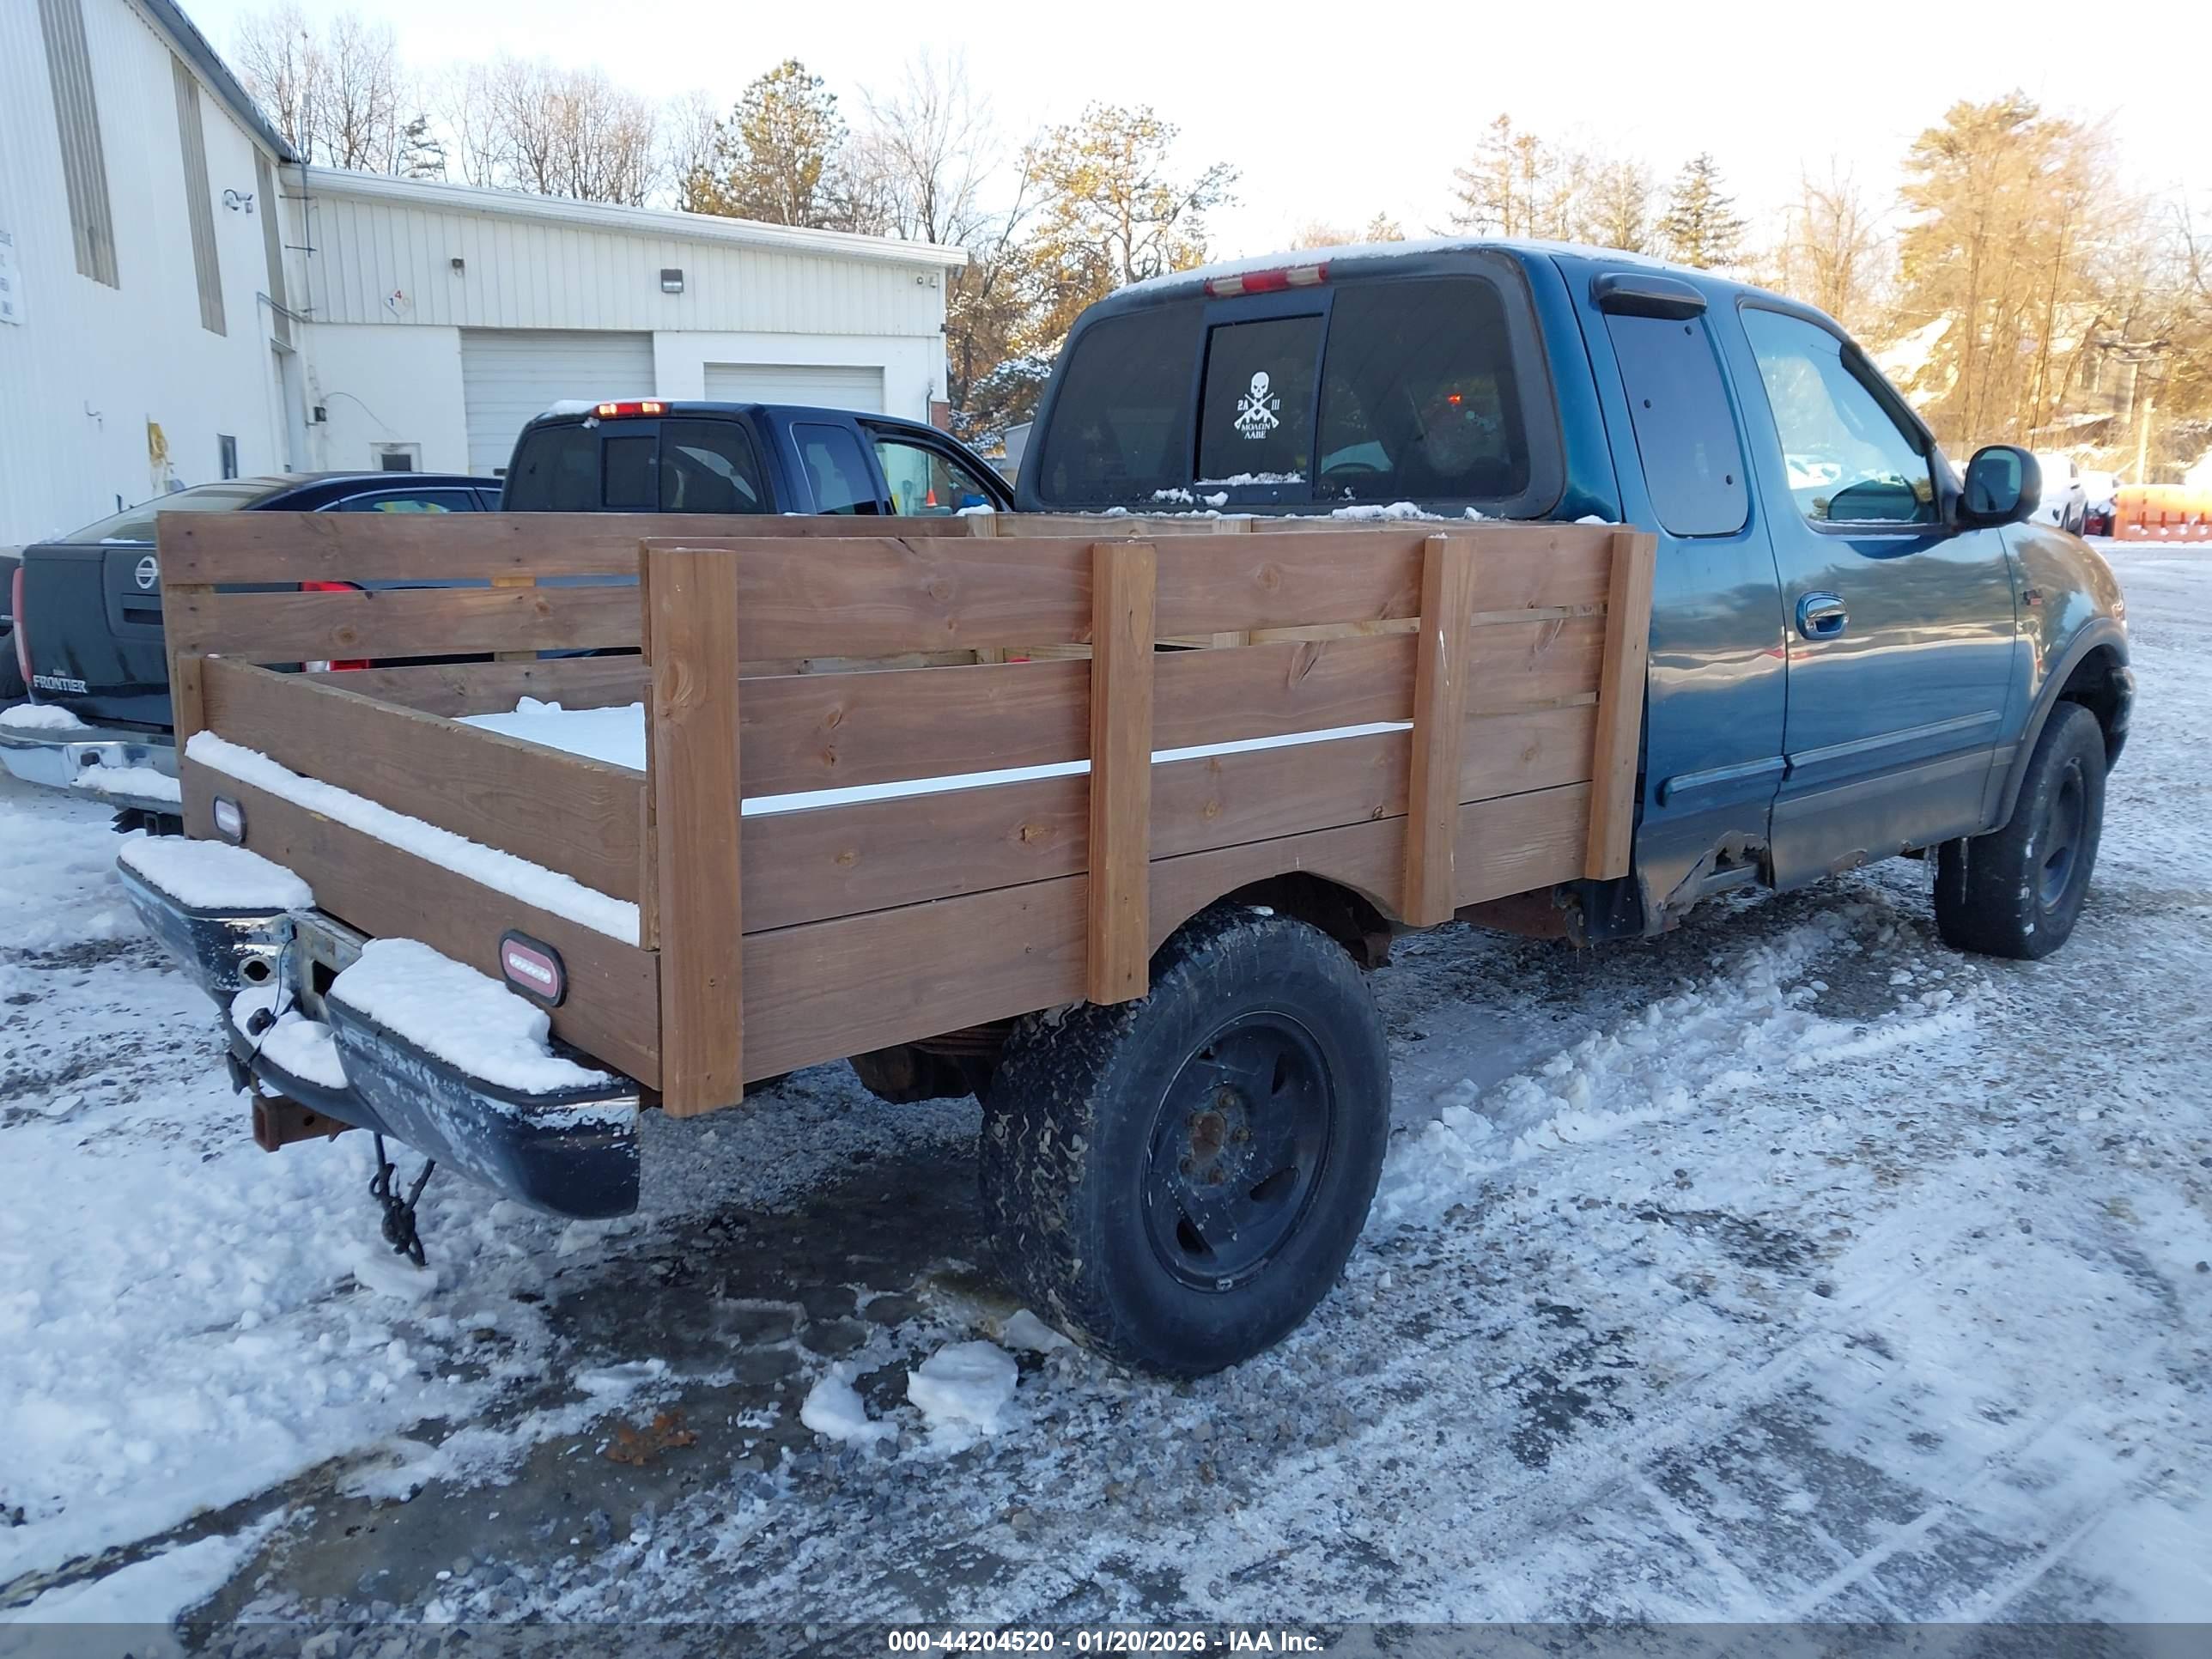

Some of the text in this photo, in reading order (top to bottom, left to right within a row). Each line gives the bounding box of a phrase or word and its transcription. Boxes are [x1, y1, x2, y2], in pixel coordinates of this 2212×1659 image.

[394, 289, 403, 300] 4
[389, 297, 394, 307] 1
[1237, 399, 1249, 411] 2A
[33, 674, 88, 694] FRONTIER
